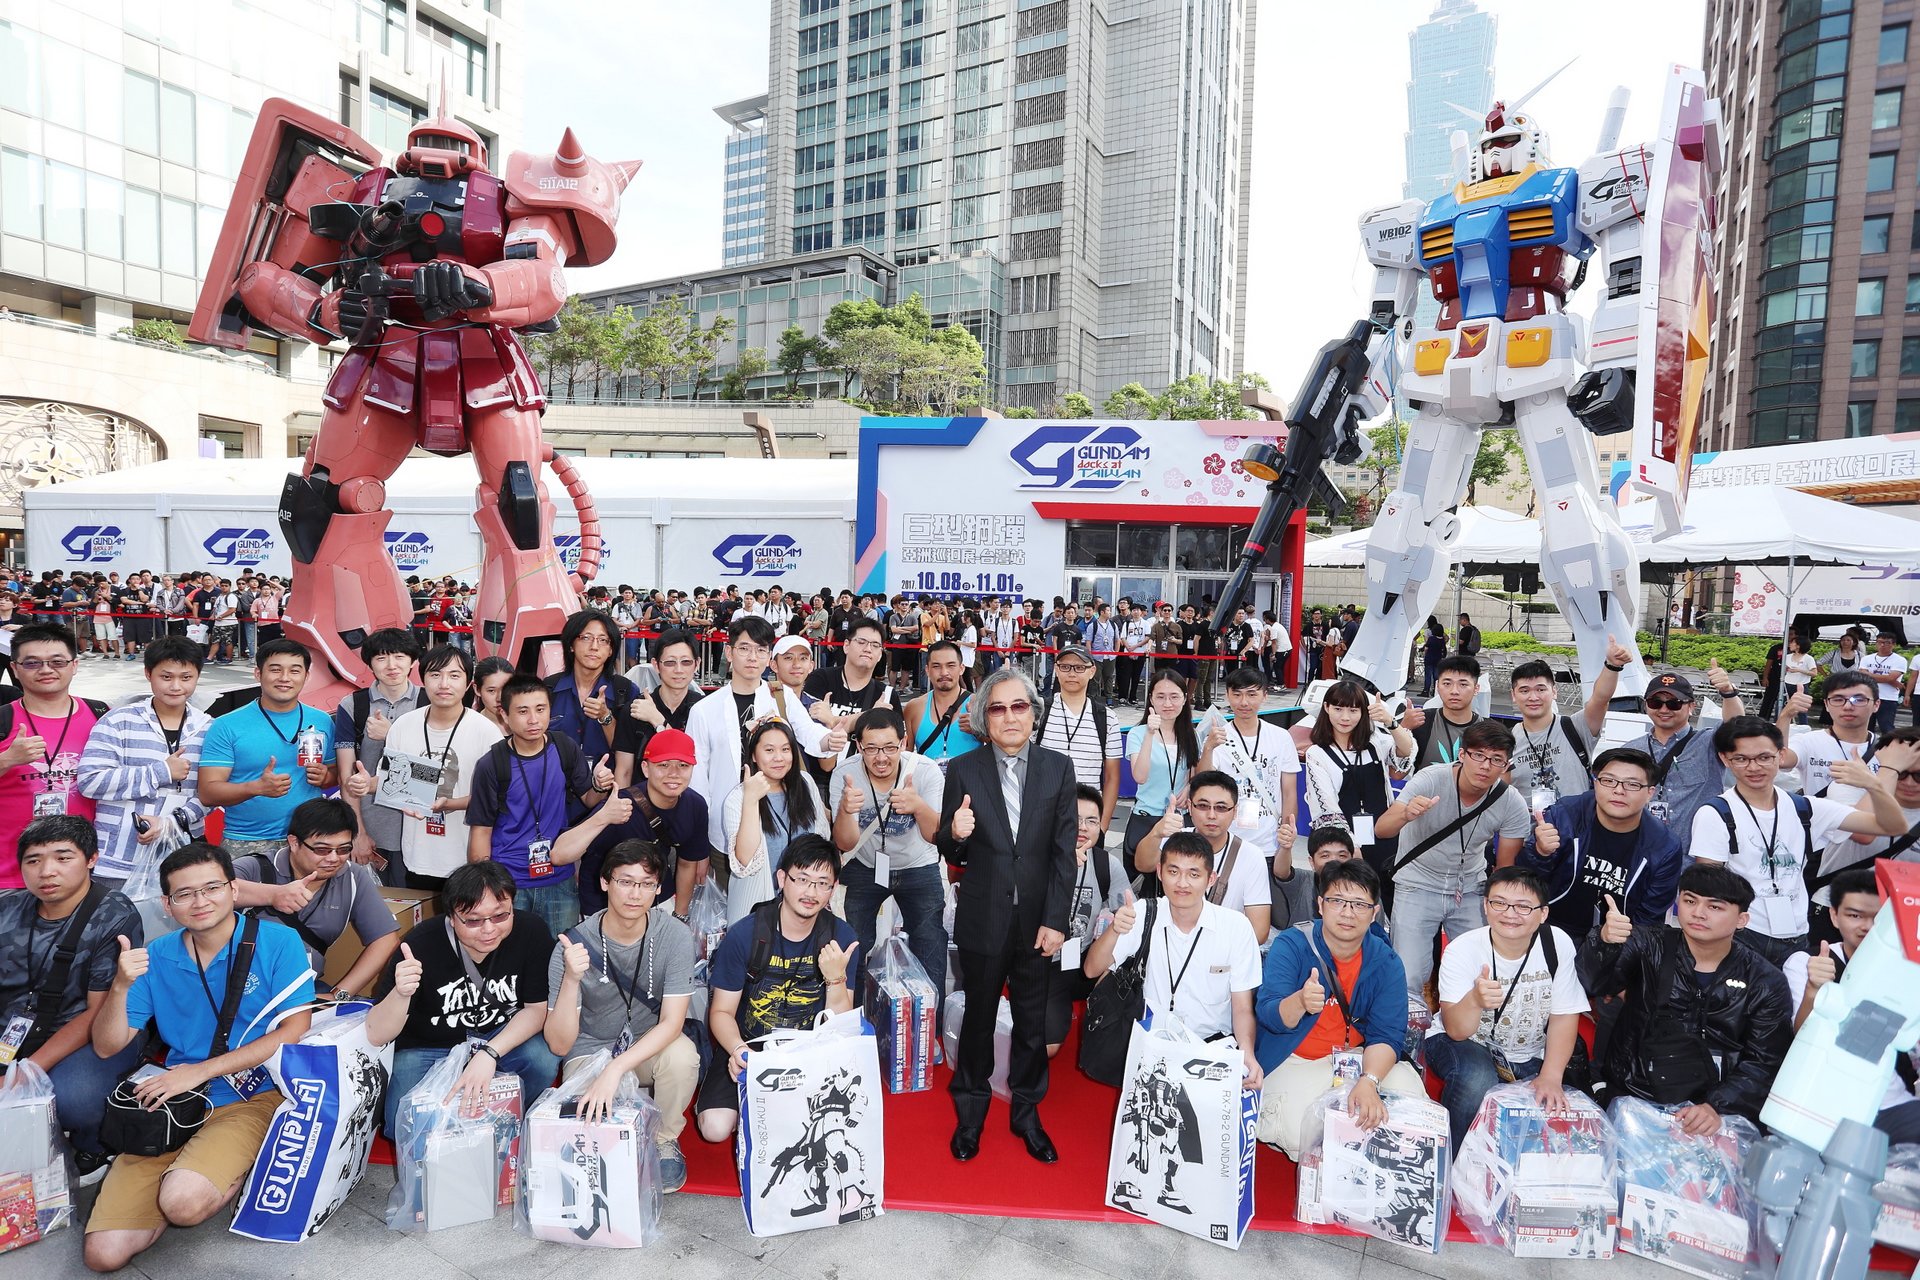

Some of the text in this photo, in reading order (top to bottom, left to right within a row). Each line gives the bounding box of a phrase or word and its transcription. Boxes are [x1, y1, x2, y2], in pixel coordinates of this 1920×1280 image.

[540, 179, 578, 190] 511A12
[1379, 225, 1412, 240] WB102
[1078, 446, 1150, 460] GUNDAM
[1110, 460, 1122, 468] at
[1078, 468, 1141, 478] TAIWAN
[902, 513, 1026, 546] 巨型鋼彈
[93, 538, 126, 546] GUNDAM
[238, 540, 274, 549] GUNDAM
[394, 544, 434, 554] GUNDAM
[754, 548, 802, 557] GUNDAM
[918, 572, 961, 590] 10.08
[976, 573, 1014, 592] 11.01
[536, 866, 548, 874] 013
[248, 1076, 260, 1092] 011
[756, 1106, 768, 1130] ZAKU
[311, 1125, 320, 1146] JAPAN
[1220, 1090, 1232, 1178] RX-78-2 GUNDAM
[262, 1084, 320, 1208] GUNPLA
